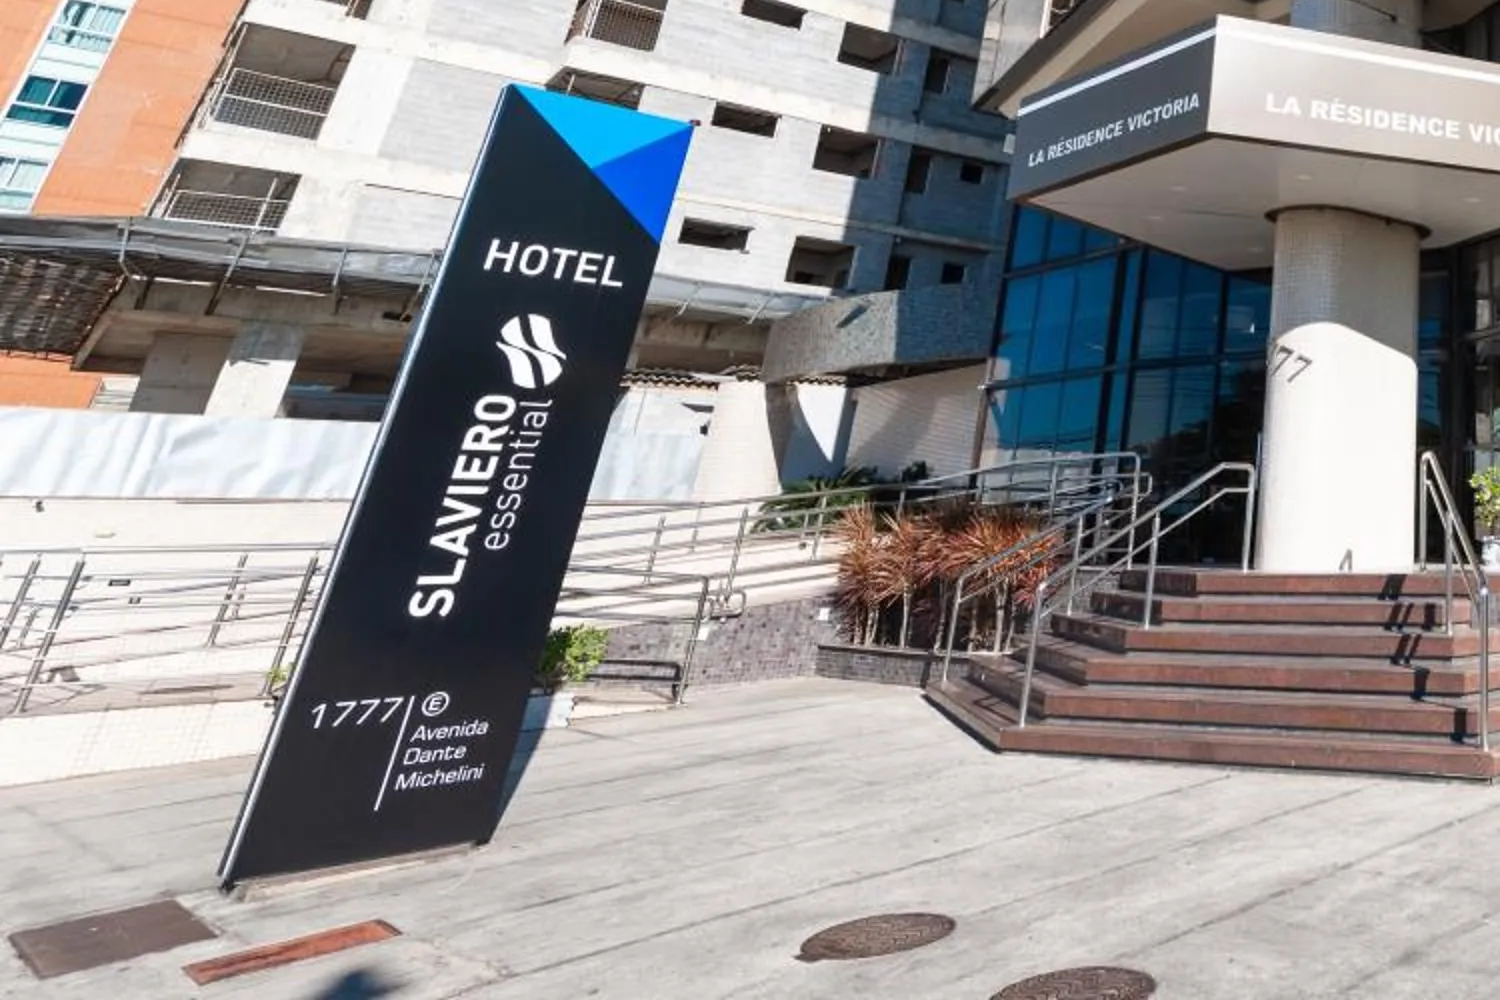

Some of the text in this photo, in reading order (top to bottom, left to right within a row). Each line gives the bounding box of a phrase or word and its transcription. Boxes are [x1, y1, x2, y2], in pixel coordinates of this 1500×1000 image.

[1027, 92, 1200, 168] LA RÉSIDENCE VICTÓRIA
[1266, 93, 1302, 117] LA
[1310, 98, 1461, 140] RÉSIDENCE
[483, 238, 624, 288] HOTEL
[1271, 342, 1313, 383] 77
[484, 399, 553, 551] essential
[408, 394, 517, 618] SLAVIERO
[311, 697, 405, 729] 1777
[410, 719, 490, 743] Avenida
[395, 763, 486, 791] Michelini
[403, 745, 468, 766] Dante
